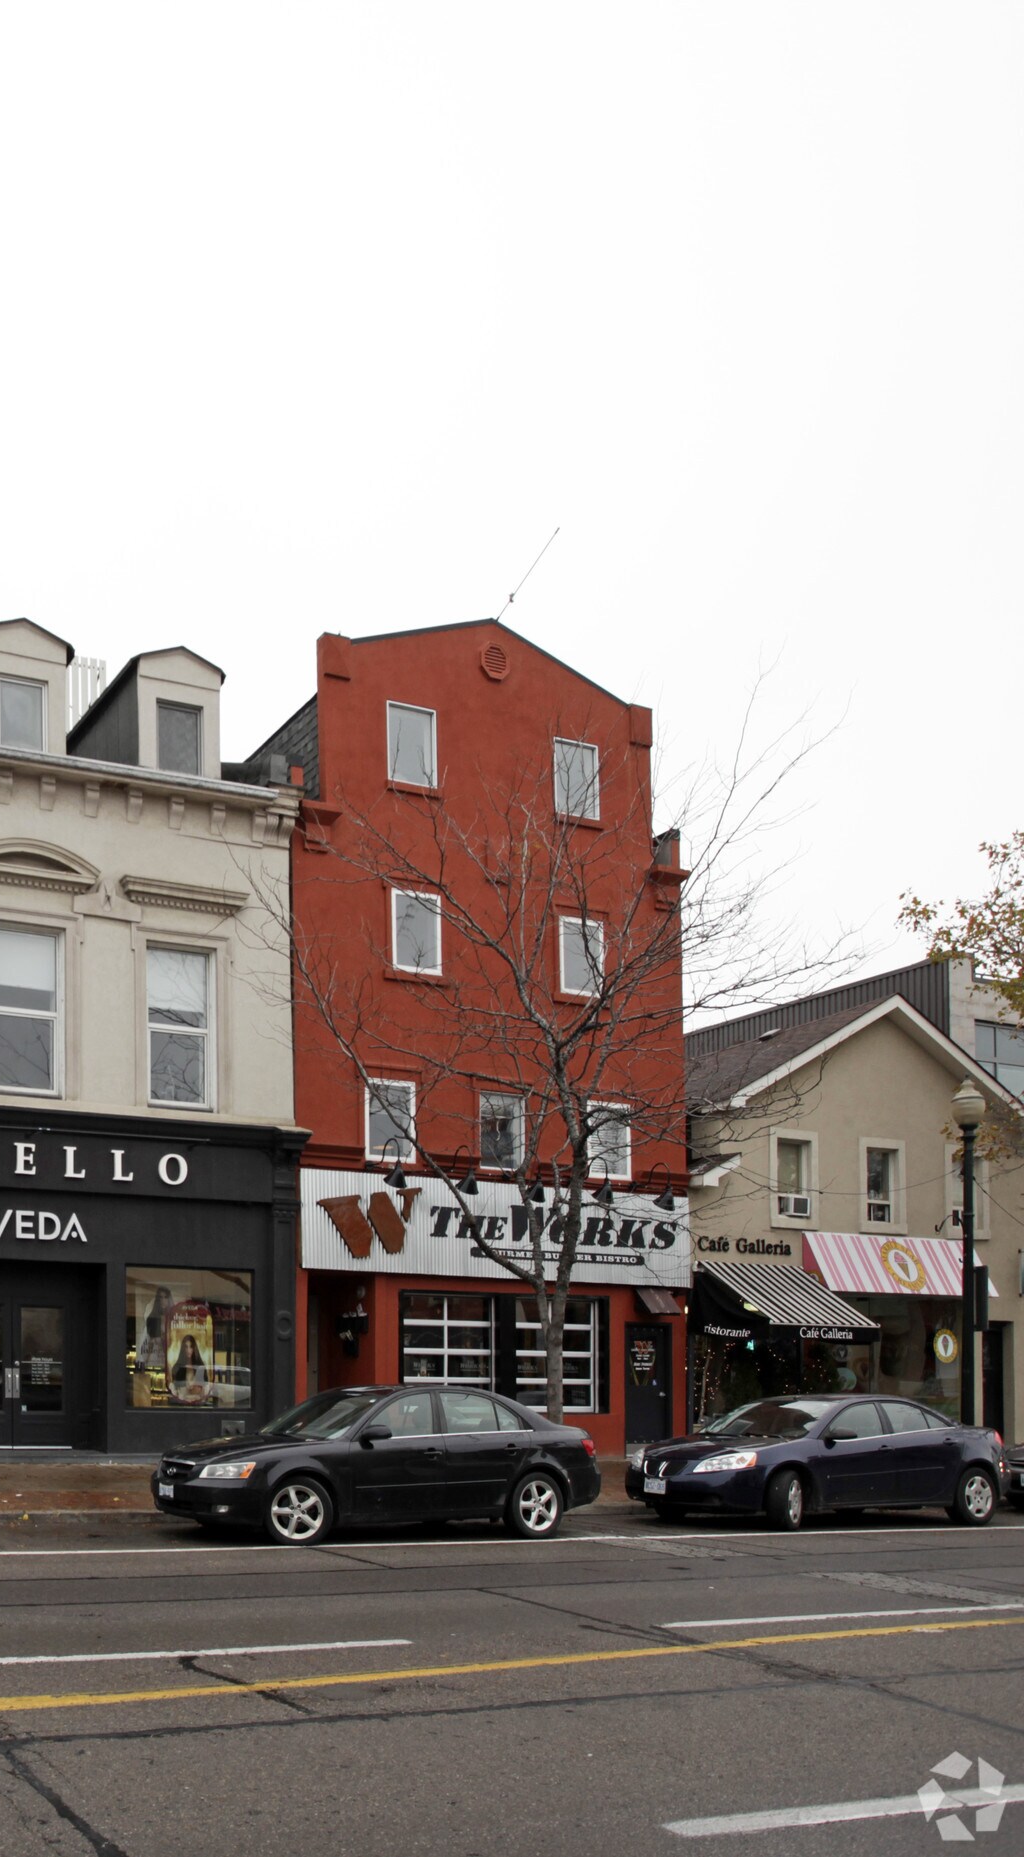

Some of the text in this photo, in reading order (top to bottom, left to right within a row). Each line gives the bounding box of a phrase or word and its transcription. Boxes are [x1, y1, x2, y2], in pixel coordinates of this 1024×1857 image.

[509, 1205, 677, 1250] WORKS
[697, 1236, 792, 1256] Café Galleria
[481, 1249, 638, 1264] URME BUER BISTRO
[704, 1323, 751, 1338] ristorante
[799, 1327, 853, 1340] Café Galleria
